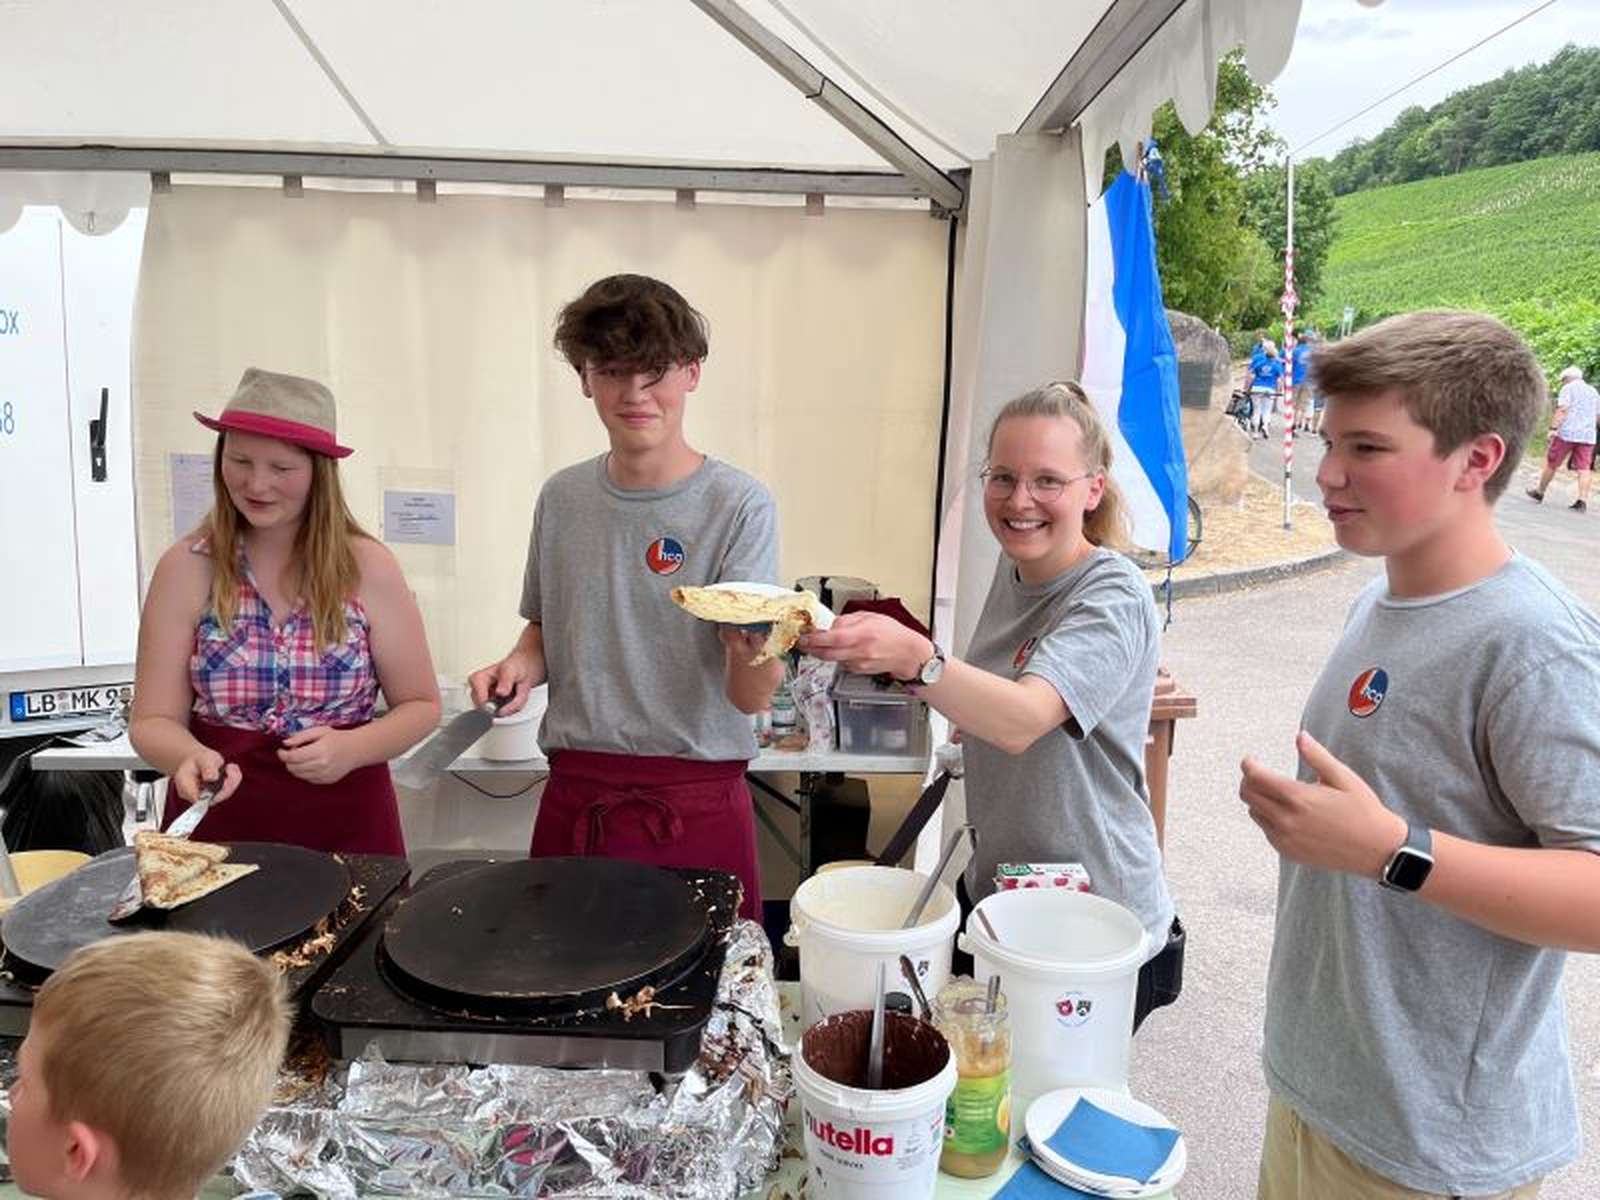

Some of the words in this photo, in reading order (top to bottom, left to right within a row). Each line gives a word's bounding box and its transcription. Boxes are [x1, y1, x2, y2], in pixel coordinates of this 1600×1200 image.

[27, 694, 56, 714] LB
[71, 690, 100, 710] MK
[804, 1107, 894, 1156] nutella
